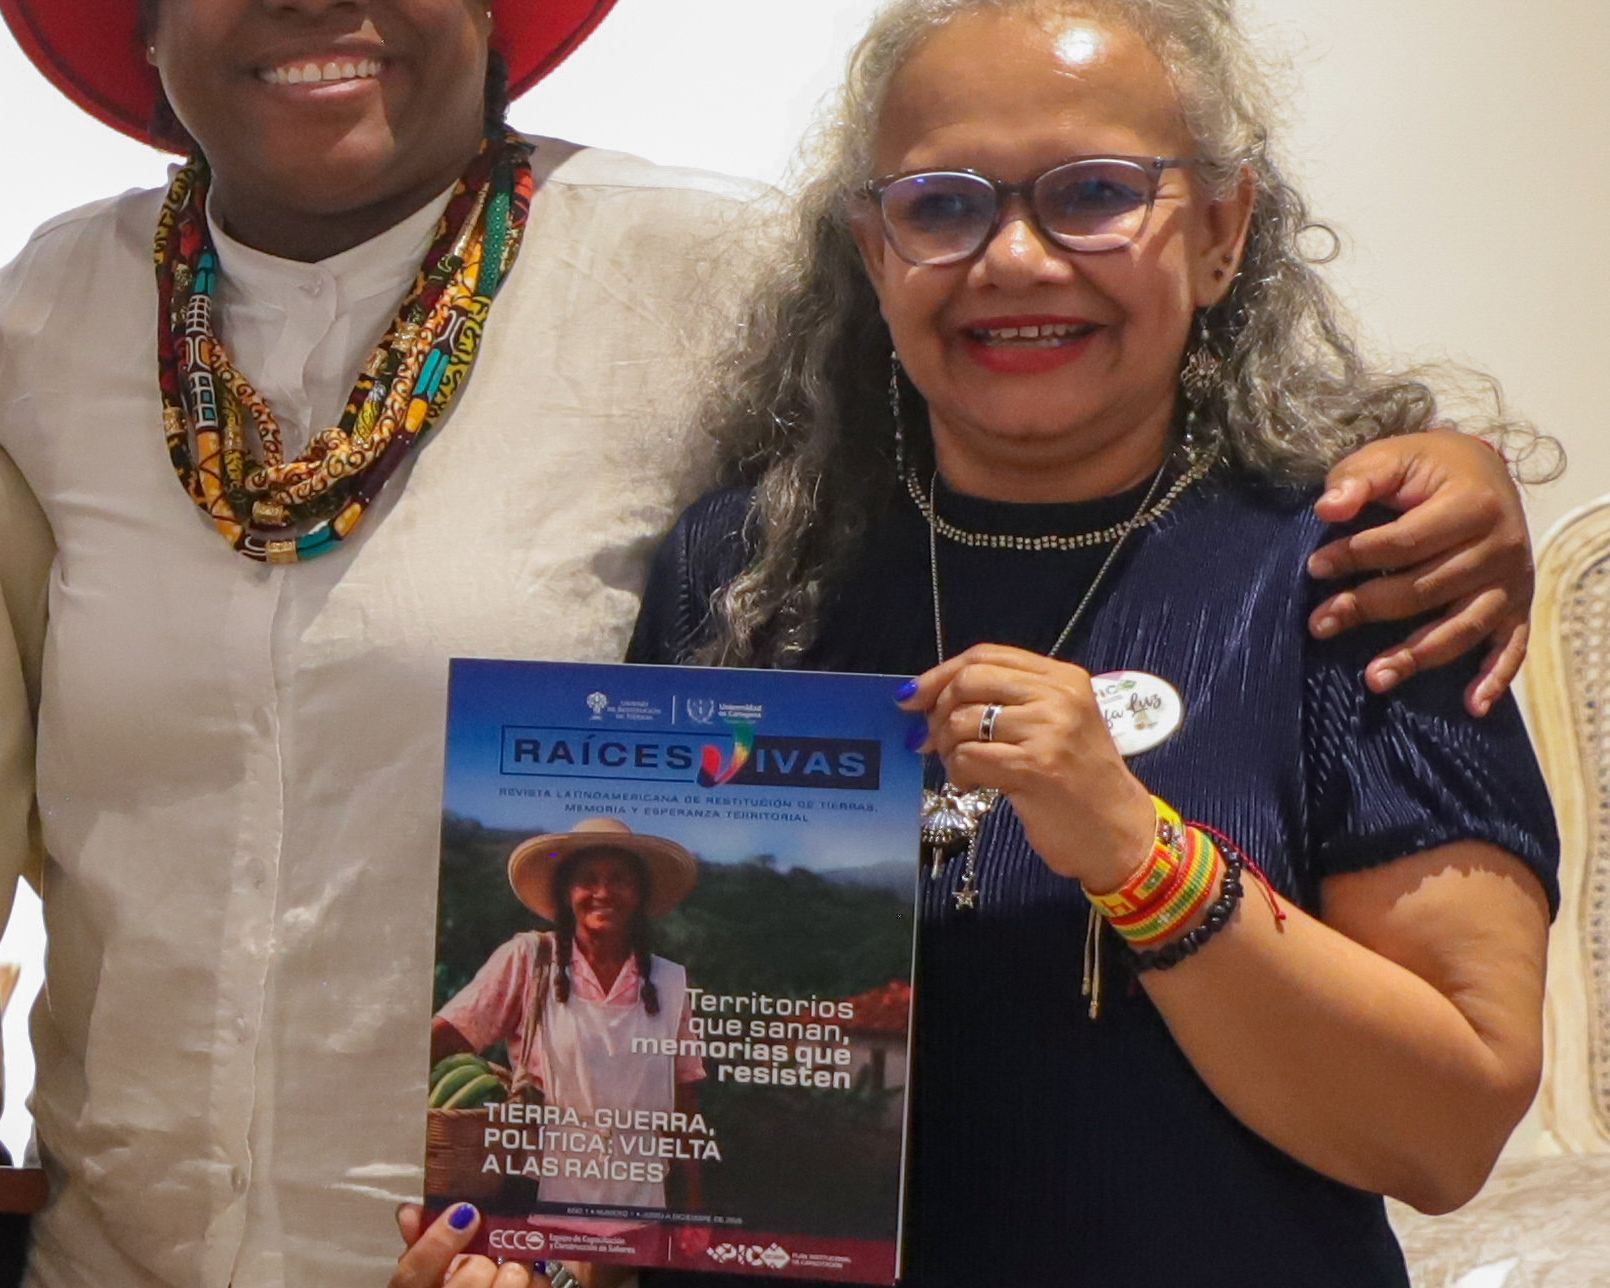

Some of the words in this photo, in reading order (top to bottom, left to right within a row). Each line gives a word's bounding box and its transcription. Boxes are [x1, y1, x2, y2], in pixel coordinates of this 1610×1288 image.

[513, 734, 693, 770] RAÍCES
[499, 787, 551, 799] REVISTA
[684, 796, 701, 805] DE
[797, 801, 814, 809] DE
[565, 804, 627, 814] MEMORIA
[630, 806, 638, 815] Y
[644, 807, 720, 818] ESPERANZA
[725, 812, 809, 823] TERRITORIAL
[684, 988, 854, 1019] Territorios
[688, 1017, 742, 1038] que
[750, 1020, 850, 1045] sanan,
[631, 1037, 789, 1062] memorias
[795, 1045, 851, 1069] que
[718, 1063, 851, 1089] resisten
[483, 1102, 589, 1128] TIERRA,
[594, 1108, 716, 1136] GUERRA,
[484, 1125, 614, 1154] POLÍTICA:
[619, 1134, 722, 1161] VUELTA
[481, 1154, 501, 1174] A
[506, 1156, 559, 1177] LAS
[565, 1155, 664, 1183] RAÍCES
